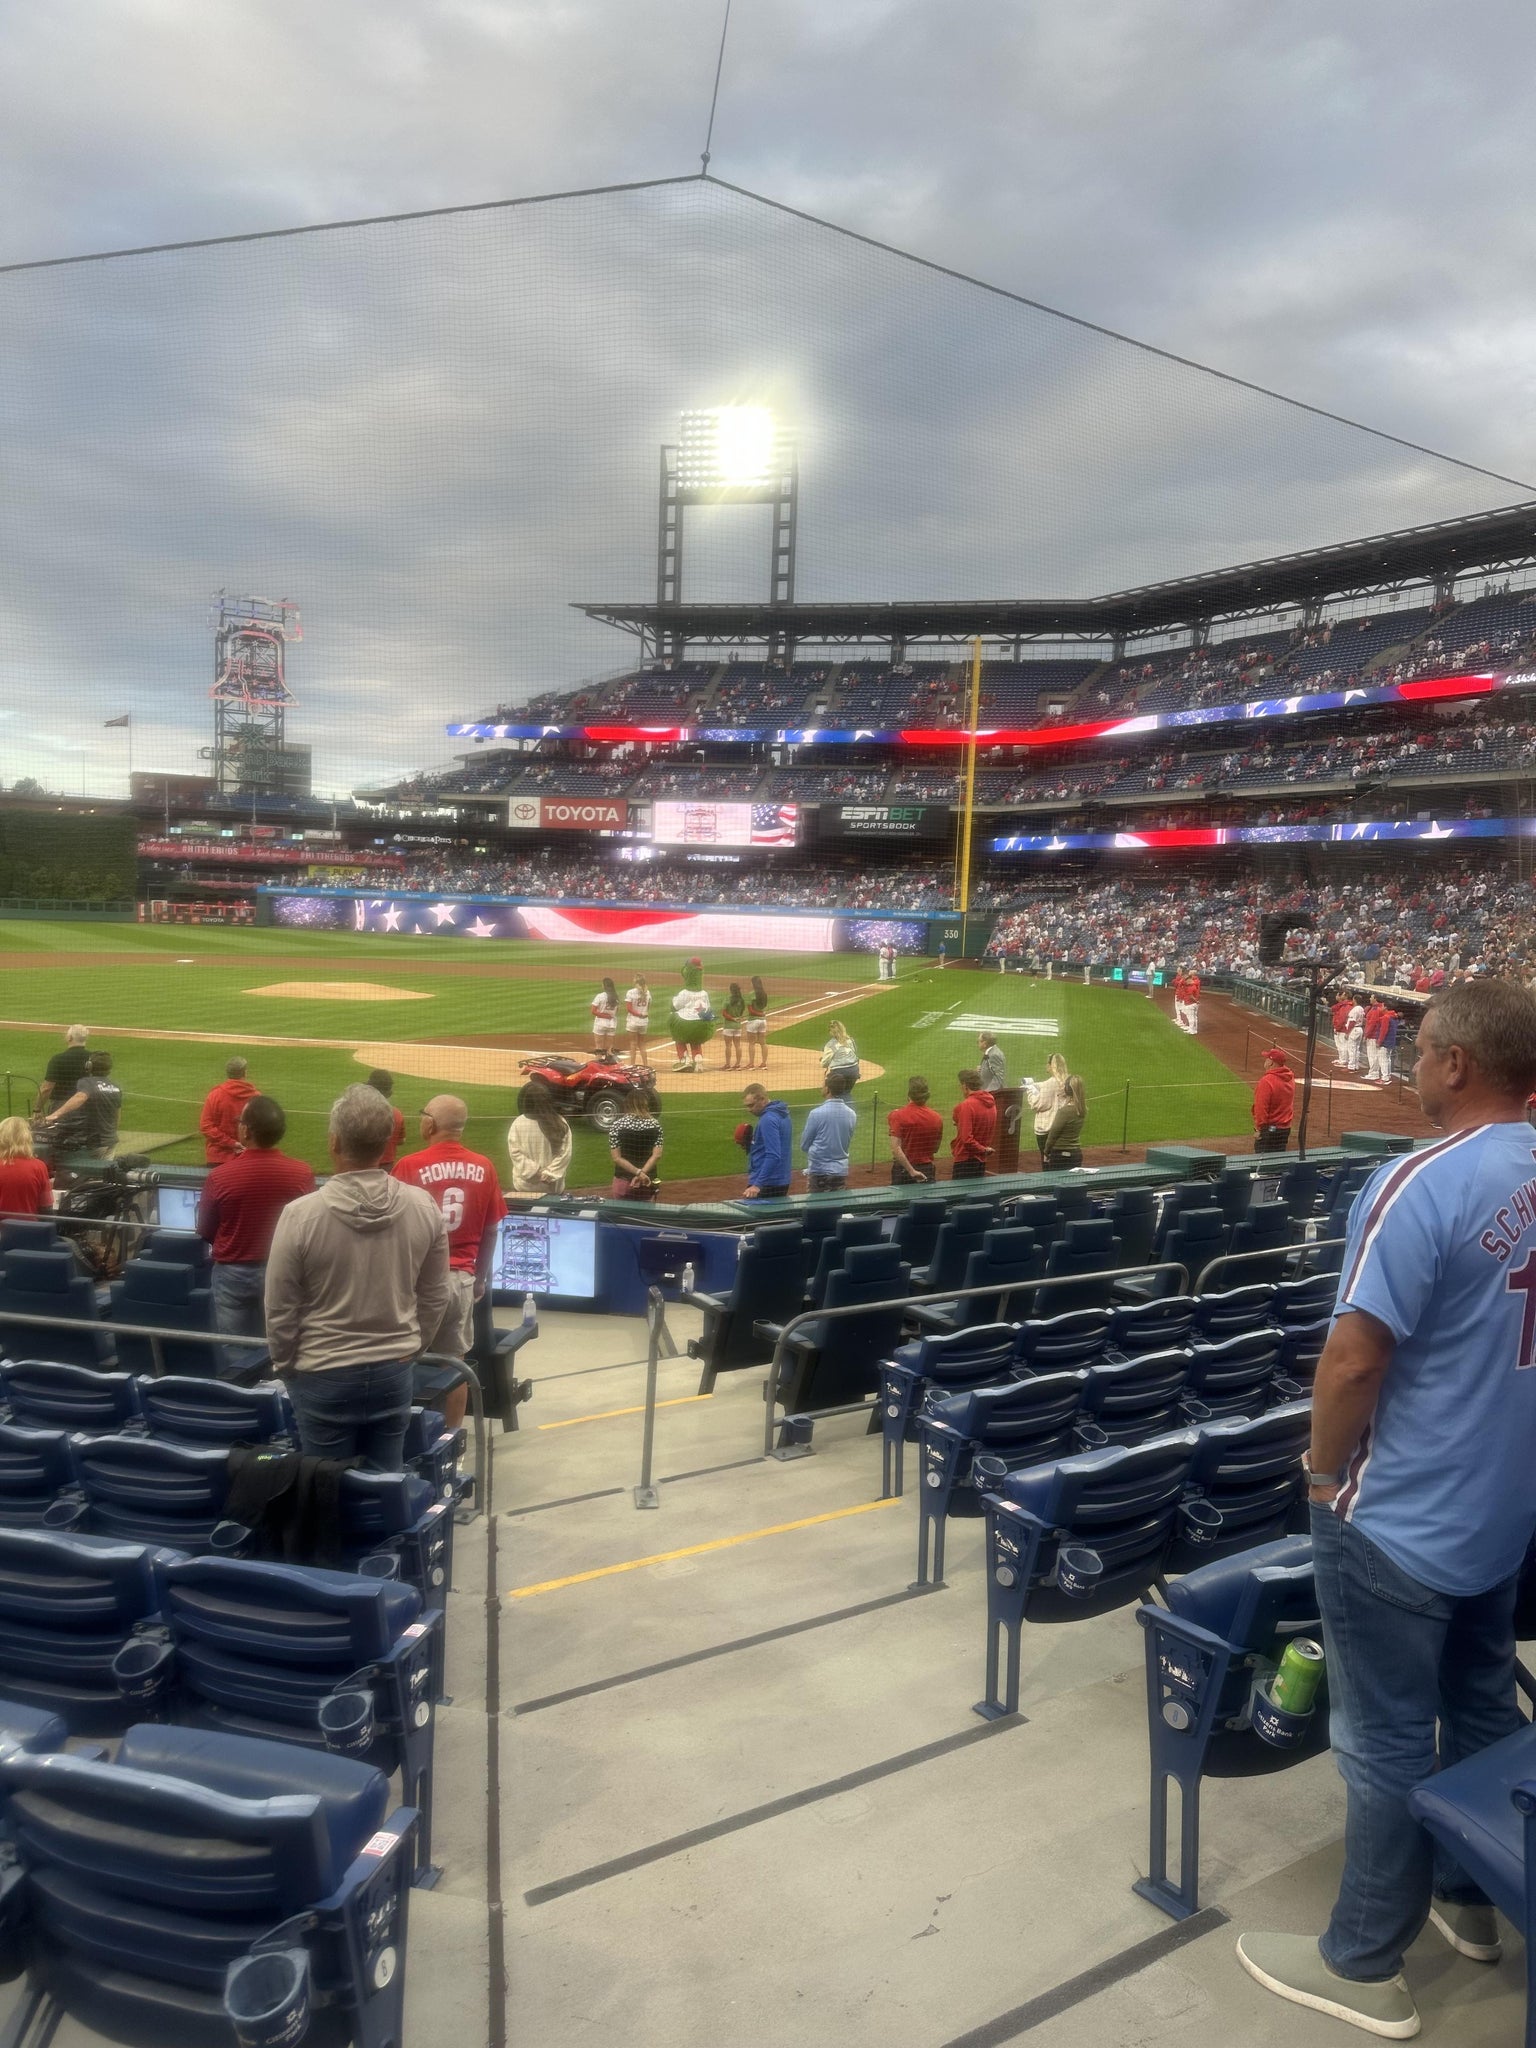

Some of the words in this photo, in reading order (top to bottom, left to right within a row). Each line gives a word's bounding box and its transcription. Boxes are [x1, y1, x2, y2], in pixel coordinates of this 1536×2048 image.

[545, 805, 620, 822] TOYOTA
[841, 806, 889, 820] ESPN
[889, 807, 927, 821] BET
[850, 822, 916, 830] SPORTSBOOK
[944, 929, 959, 939] 330
[418, 1161, 485, 1185] HOWARD
[442, 1186, 465, 1232] 6
[1262, 1724, 1276, 1739] Park
[1276, 1727, 1293, 1737] Bank
